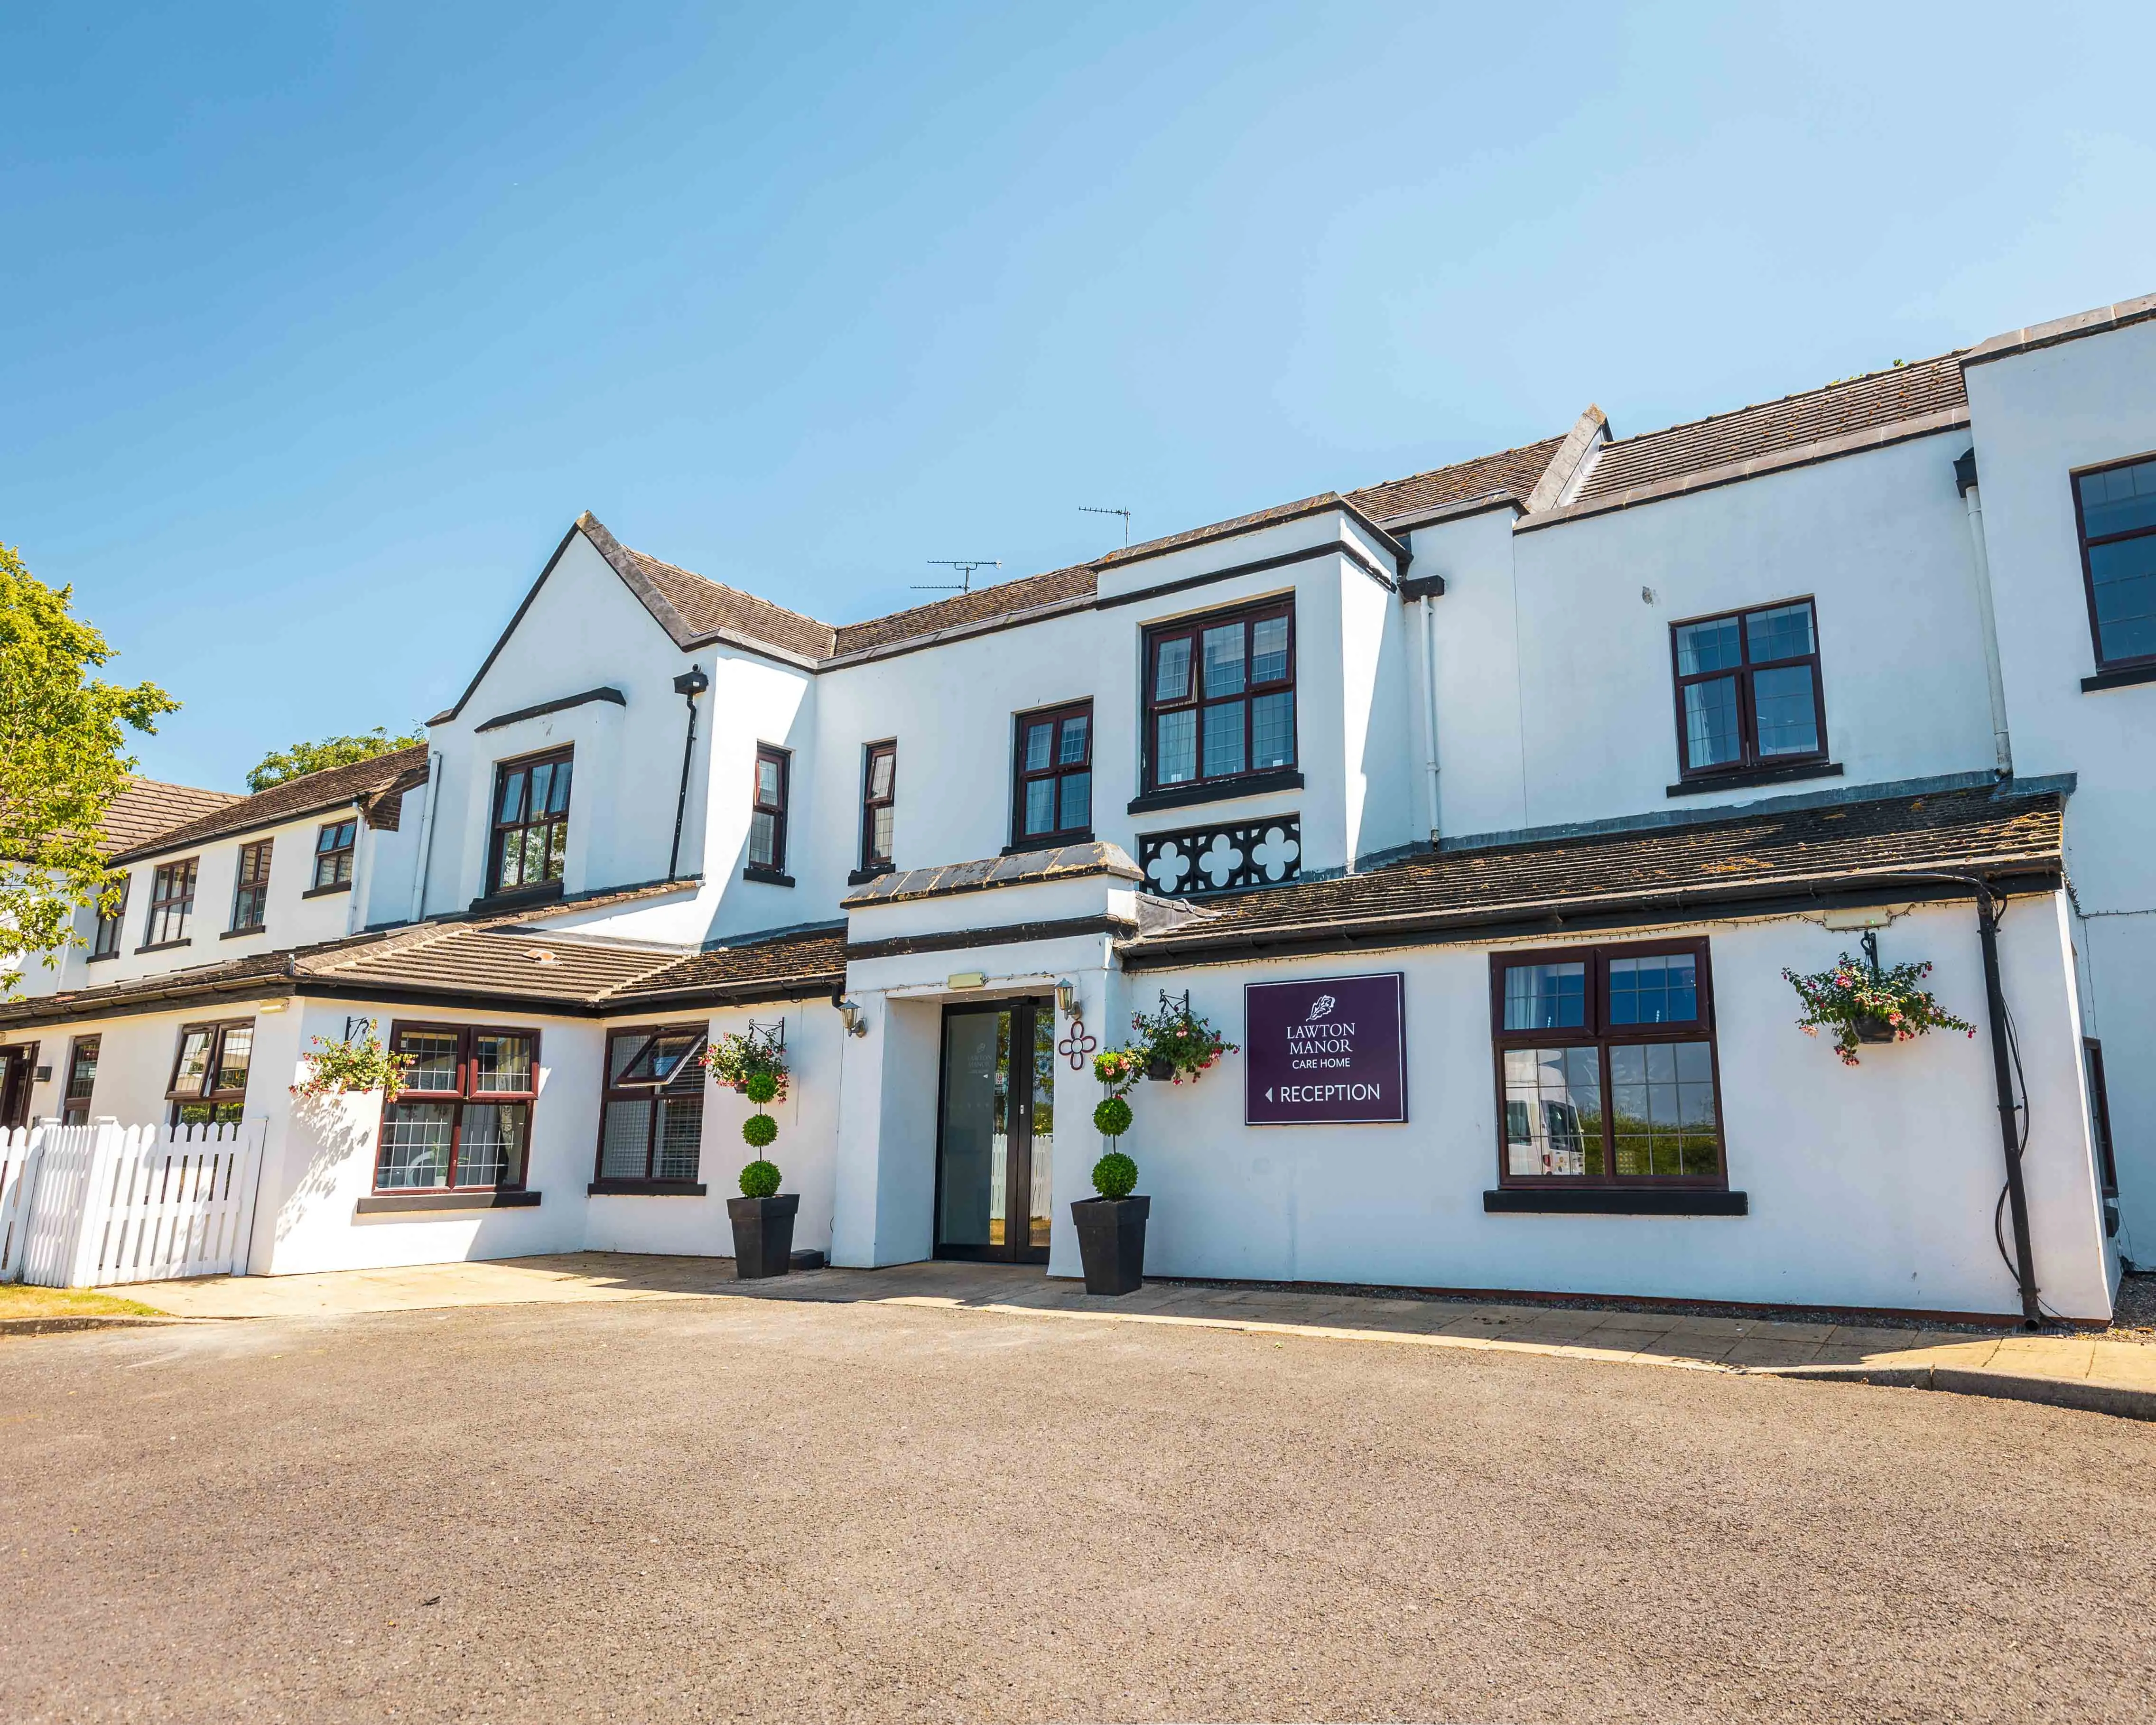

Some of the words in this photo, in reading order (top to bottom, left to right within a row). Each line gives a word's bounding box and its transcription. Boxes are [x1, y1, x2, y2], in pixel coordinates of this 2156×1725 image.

[1286, 1023, 1356, 1039] LAWTON
[1290, 1039, 1353, 1054] MANOR
[1292, 1059, 1318, 1069] CARE
[1320, 1058, 1350, 1068] HOME
[1281, 1083, 1380, 1102] RECEPTION
